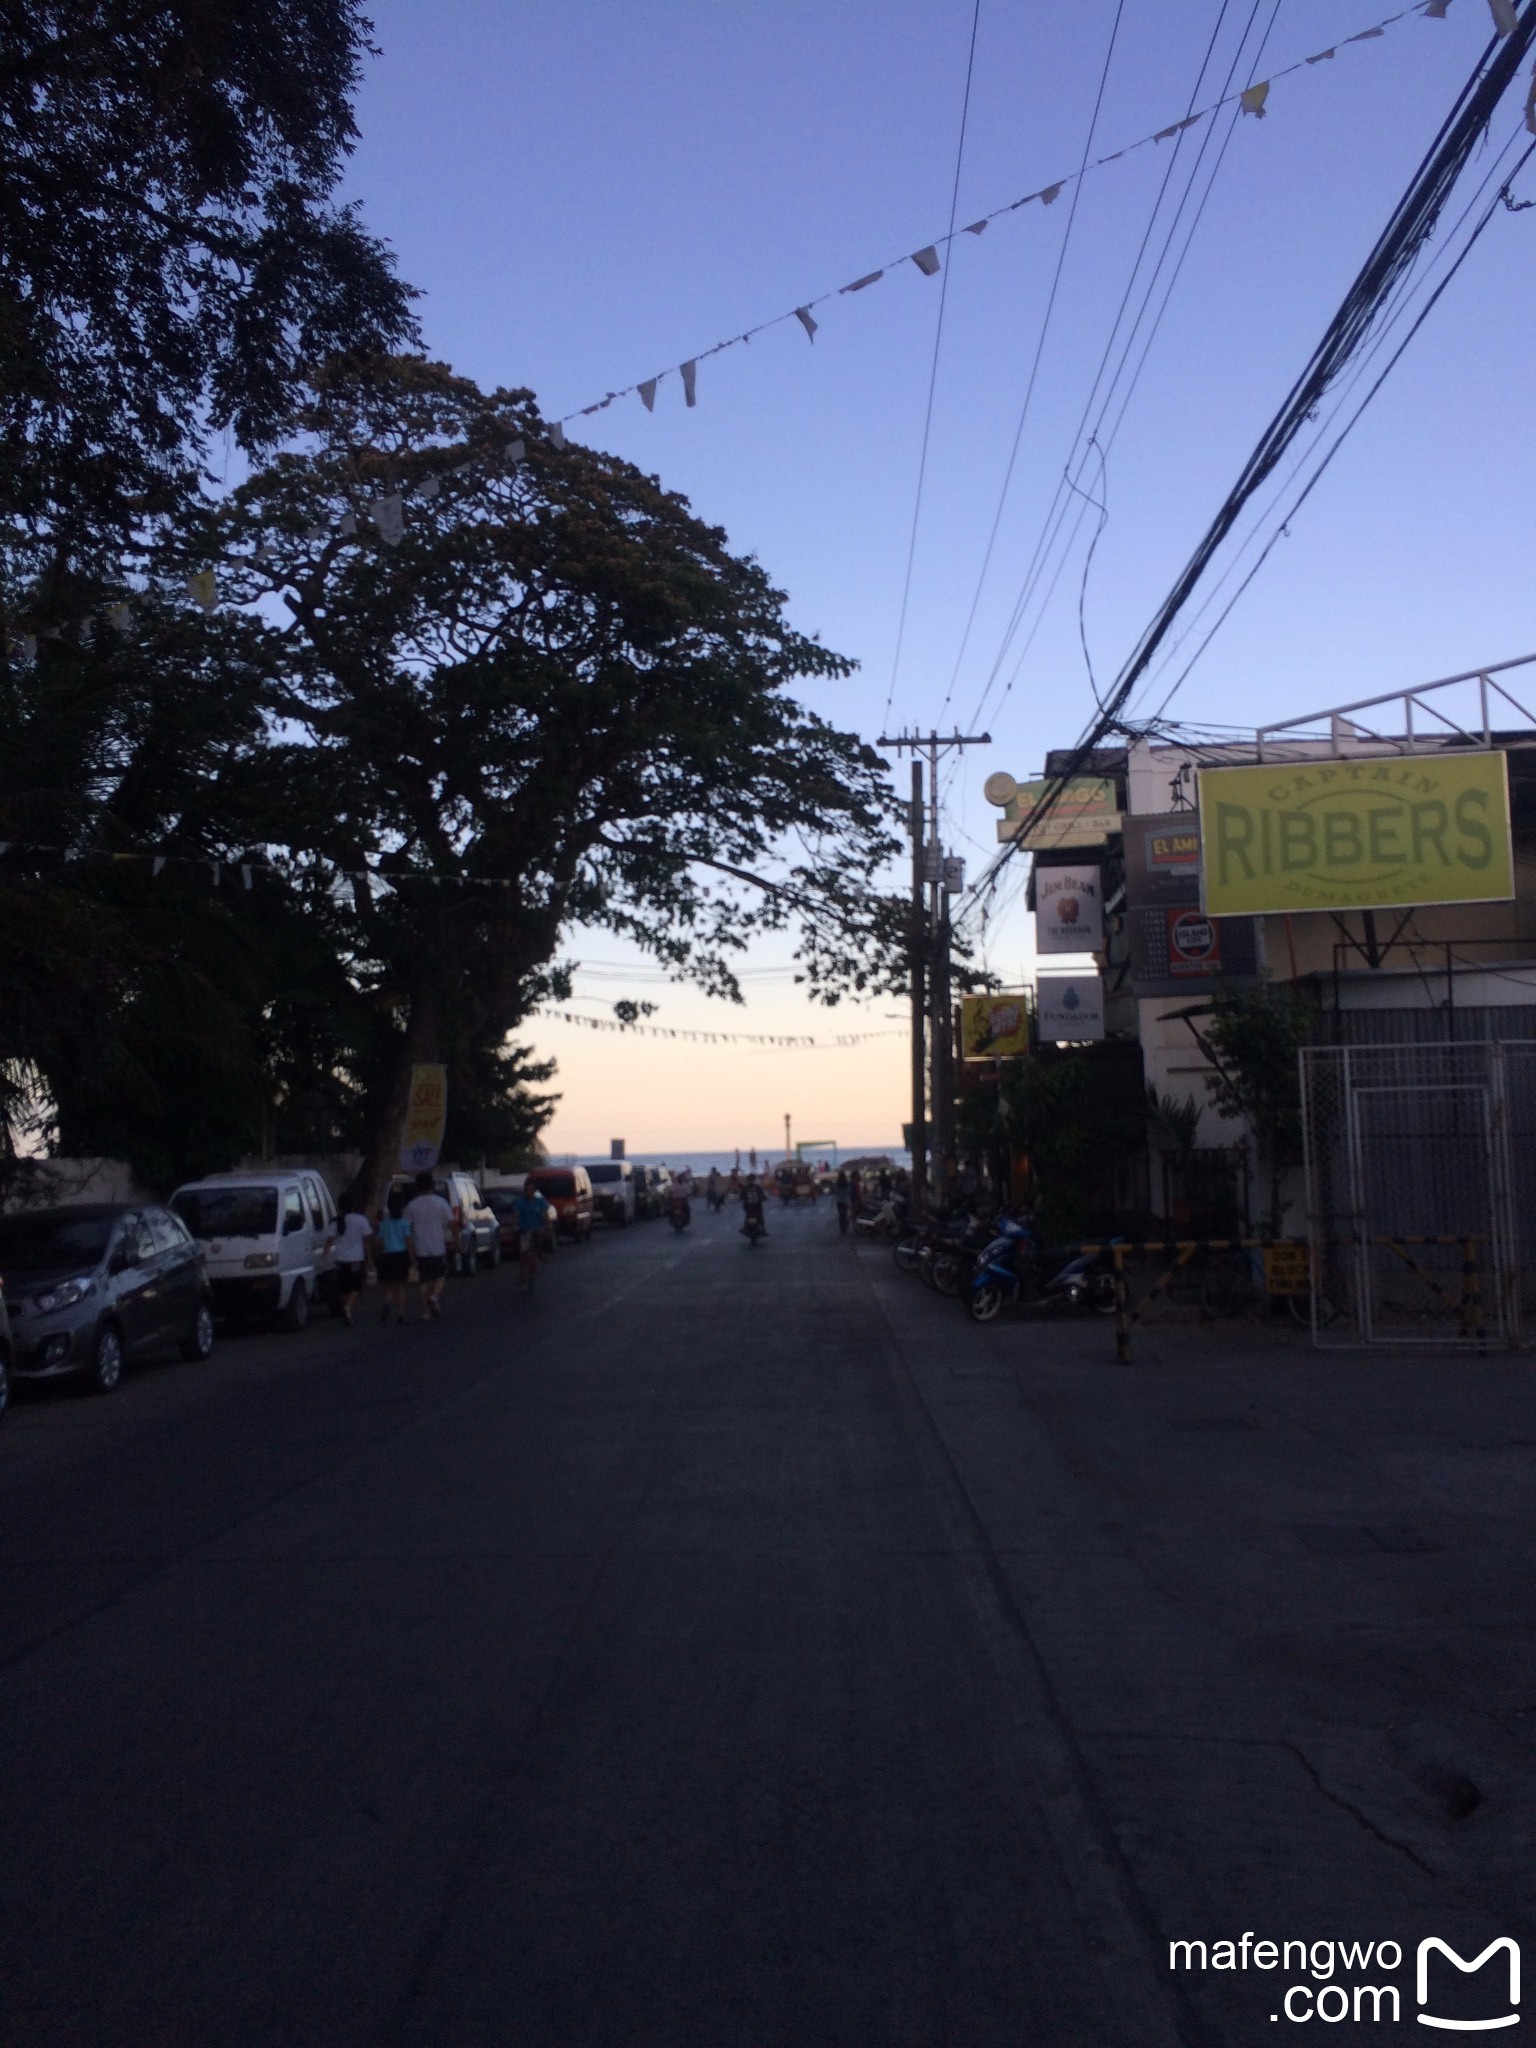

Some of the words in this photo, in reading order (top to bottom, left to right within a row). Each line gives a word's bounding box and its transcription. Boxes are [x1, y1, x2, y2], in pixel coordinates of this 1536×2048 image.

[1269, 767, 1440, 801] CAPTAIN
[1153, 838, 1169, 855] EL
[1217, 788, 1492, 885] RIBBERS
[1041, 880, 1062, 899] JIM
[1064, 876, 1095, 898] BEAM
